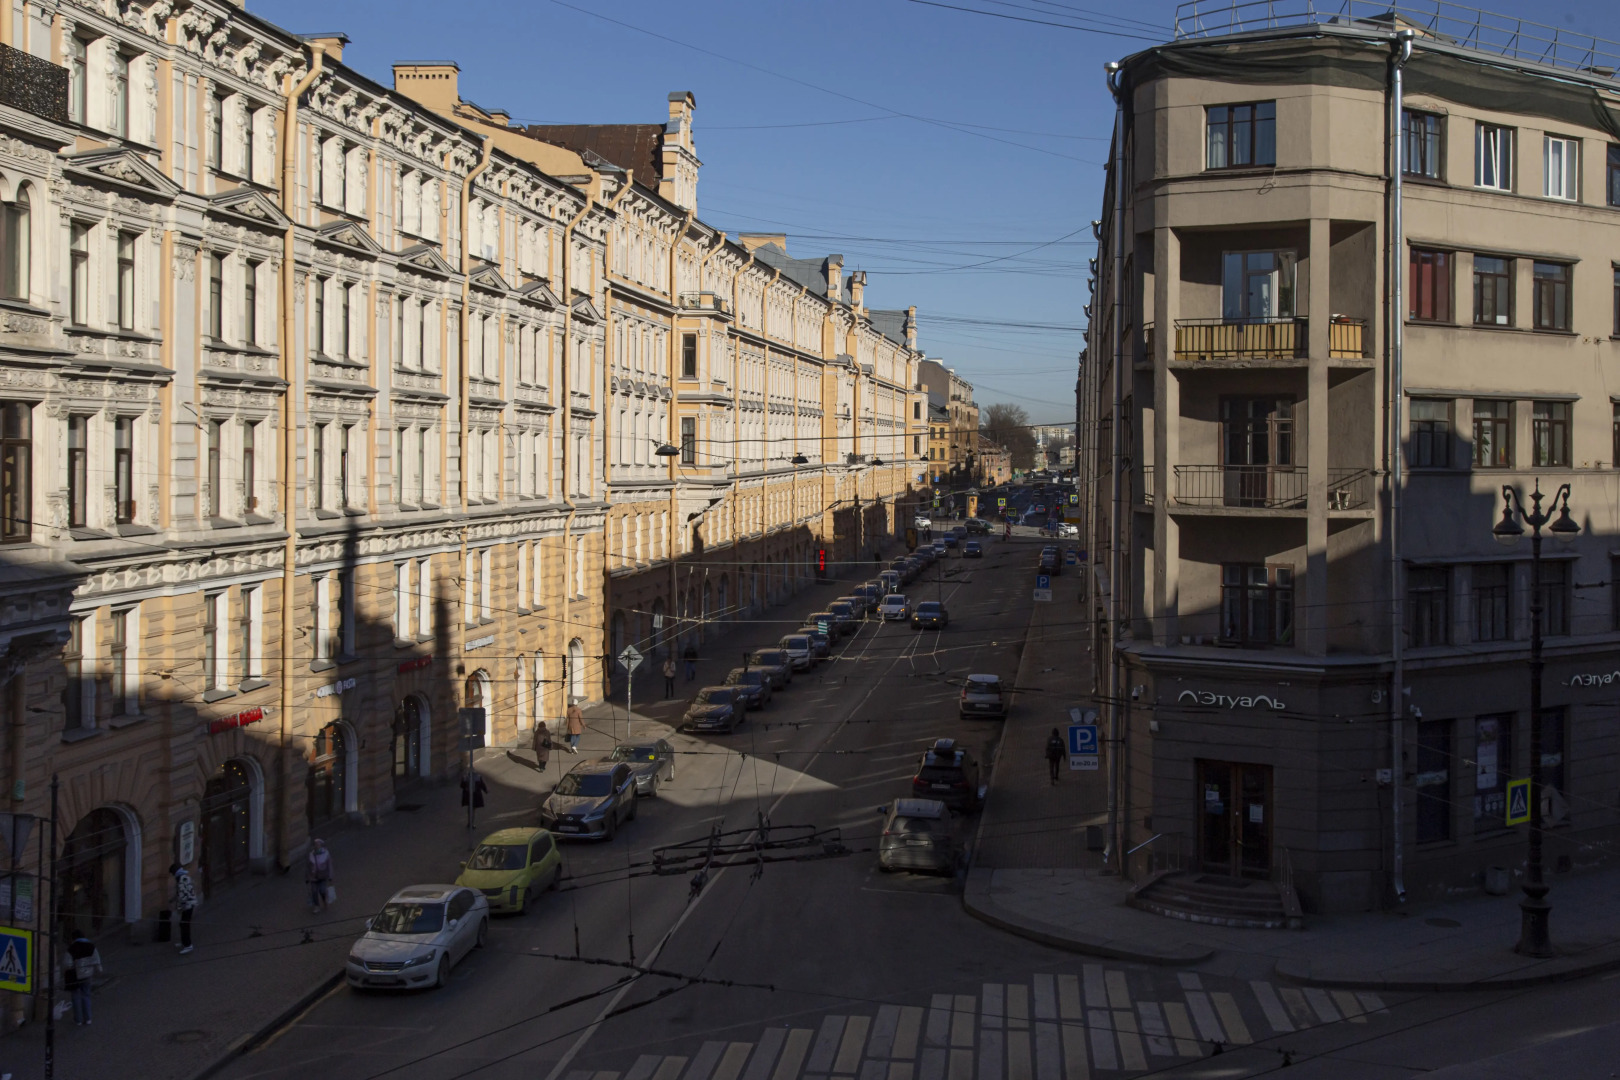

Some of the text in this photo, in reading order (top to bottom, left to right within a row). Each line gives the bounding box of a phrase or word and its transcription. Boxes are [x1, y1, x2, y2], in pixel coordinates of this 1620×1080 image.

[1040, 576, 1048, 587] P
[1177, 689, 1286, 710] Л'Этуаль
[1076, 728, 1092, 752] P
